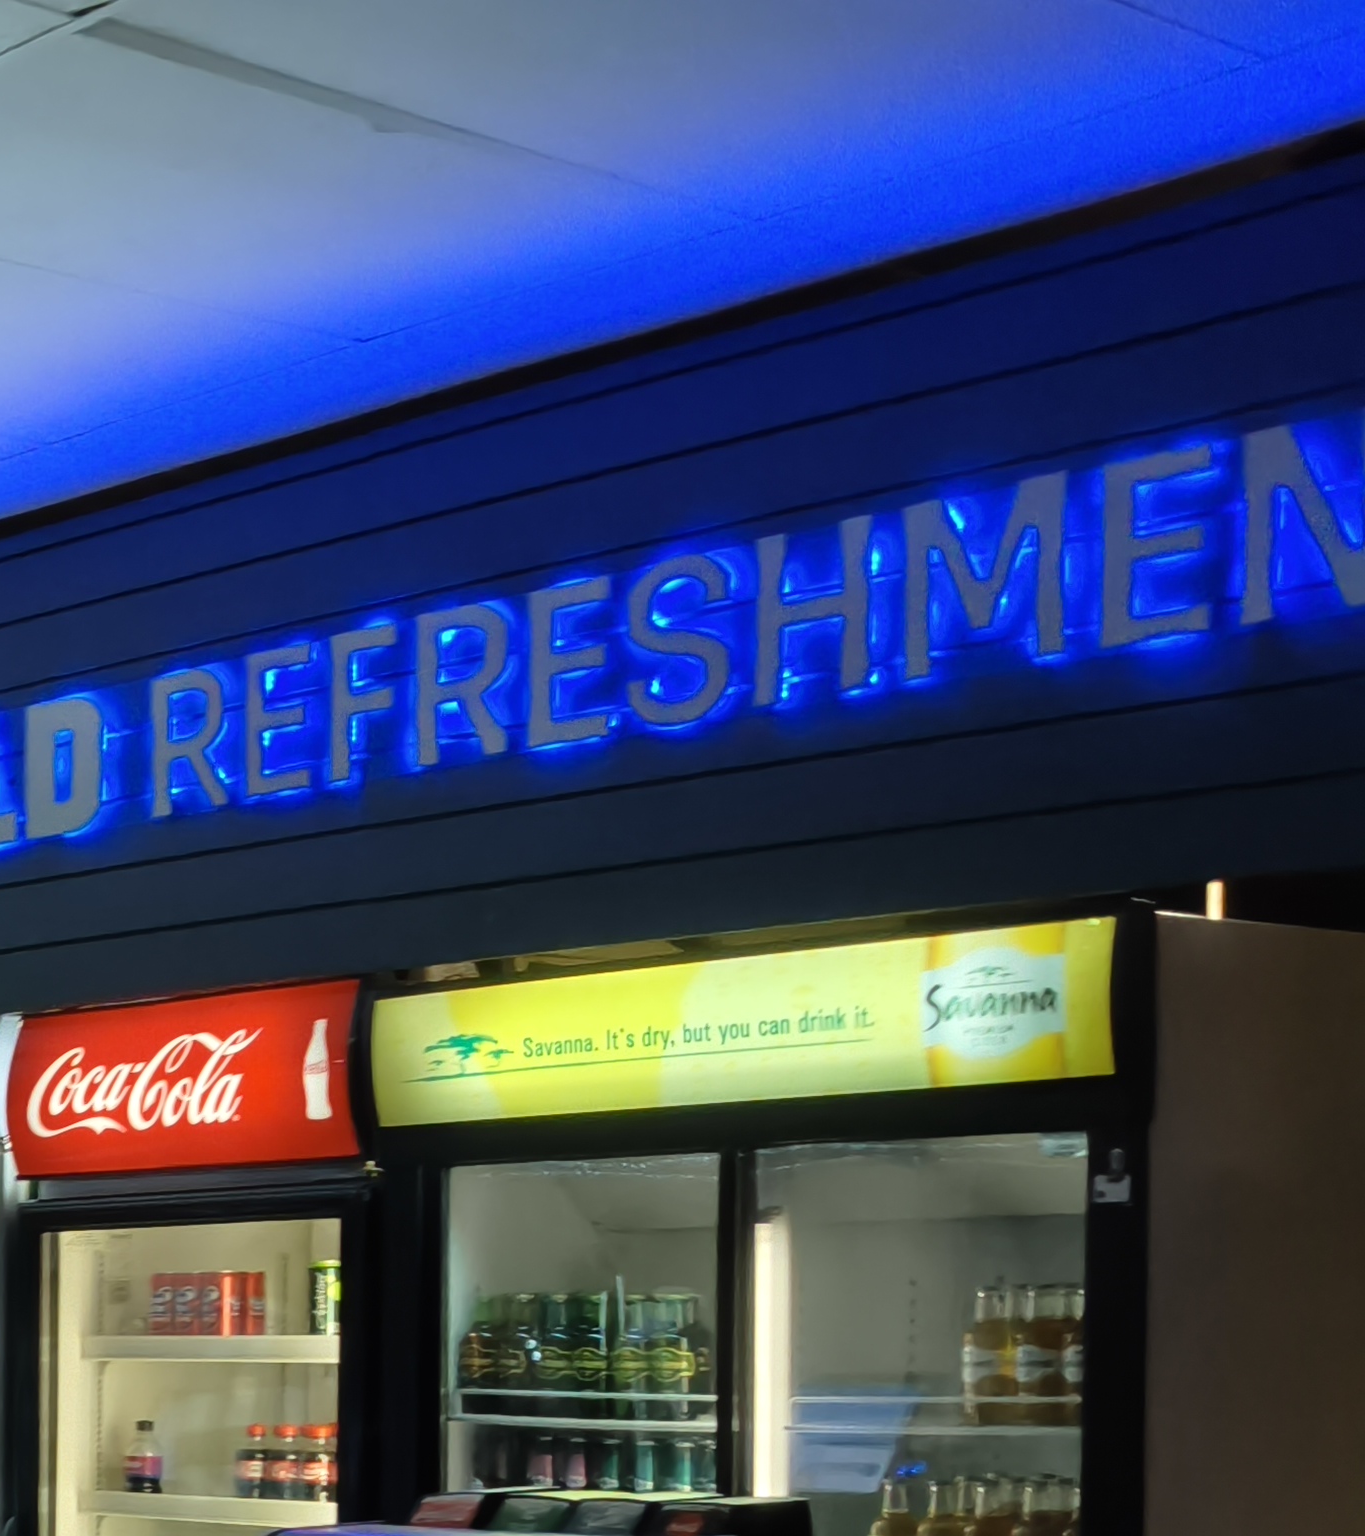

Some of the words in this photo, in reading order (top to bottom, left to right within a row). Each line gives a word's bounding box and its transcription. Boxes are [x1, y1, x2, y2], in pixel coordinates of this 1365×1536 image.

[522, 1037, 599, 1059] Savanna.
[606, 1029, 635, 1051] It's
[642, 1027, 676, 1050] dry,
[682, 1023, 712, 1044] but
[718, 1022, 751, 1045] you
[758, 1019, 790, 1037] can
[798, 1008, 847, 1034] drink
[923, 983, 1058, 1033] Savanna
[26, 1026, 265, 1139] Coca-Cola
